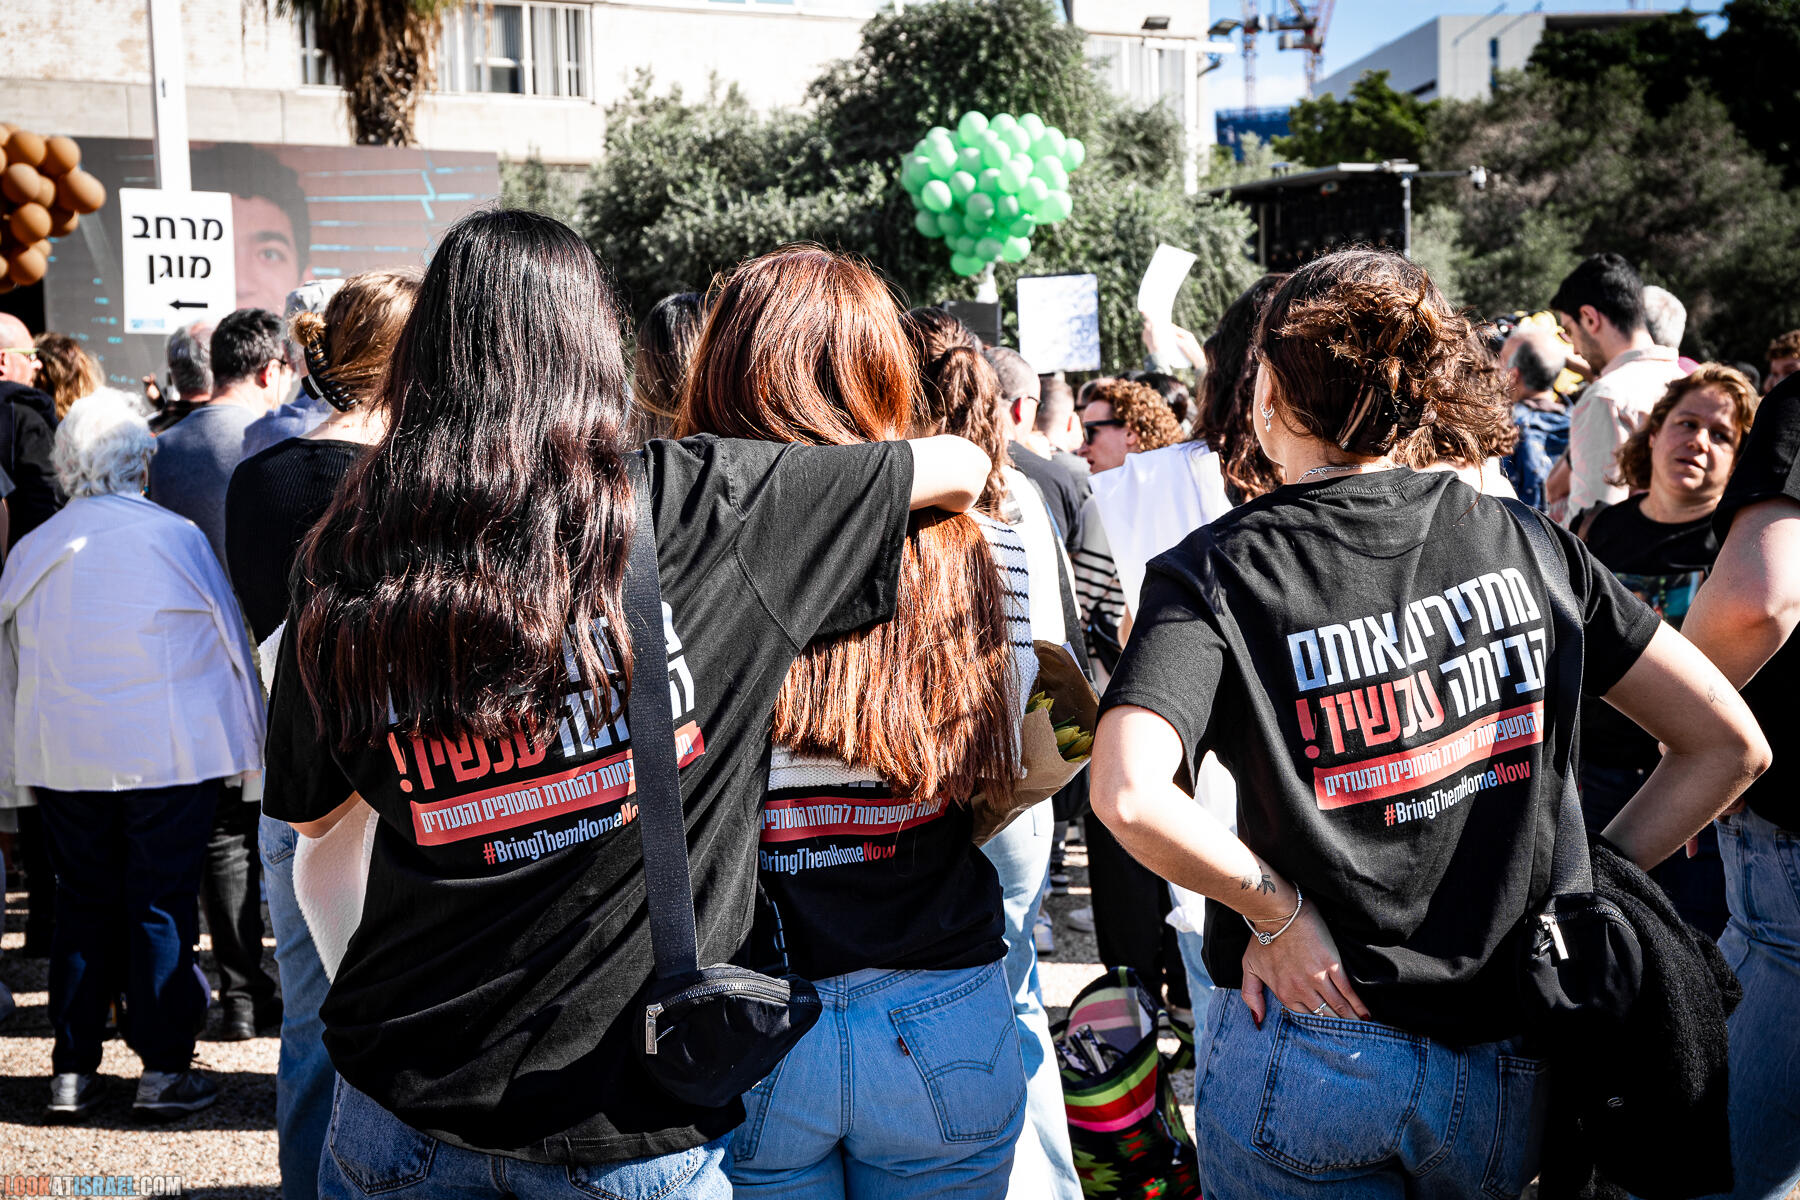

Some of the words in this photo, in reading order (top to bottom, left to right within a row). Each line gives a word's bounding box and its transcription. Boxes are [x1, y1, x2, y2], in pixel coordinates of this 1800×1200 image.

[132, 215, 223, 241] מרחב
[148, 254, 211, 284] מוגן
[1287, 612, 1407, 692] אותם
[1438, 627, 1547, 718] הביתה
[1295, 669, 1445, 759] עכשיו!
[481, 787, 544, 821] החטופים
[1324, 764, 1388, 798] והנעדרים
[1384, 760, 1532, 827] #BringThemHomeNow
[420, 801, 483, 834] והנעדרים
[483, 802, 639, 866] #BringThemHomeNo
